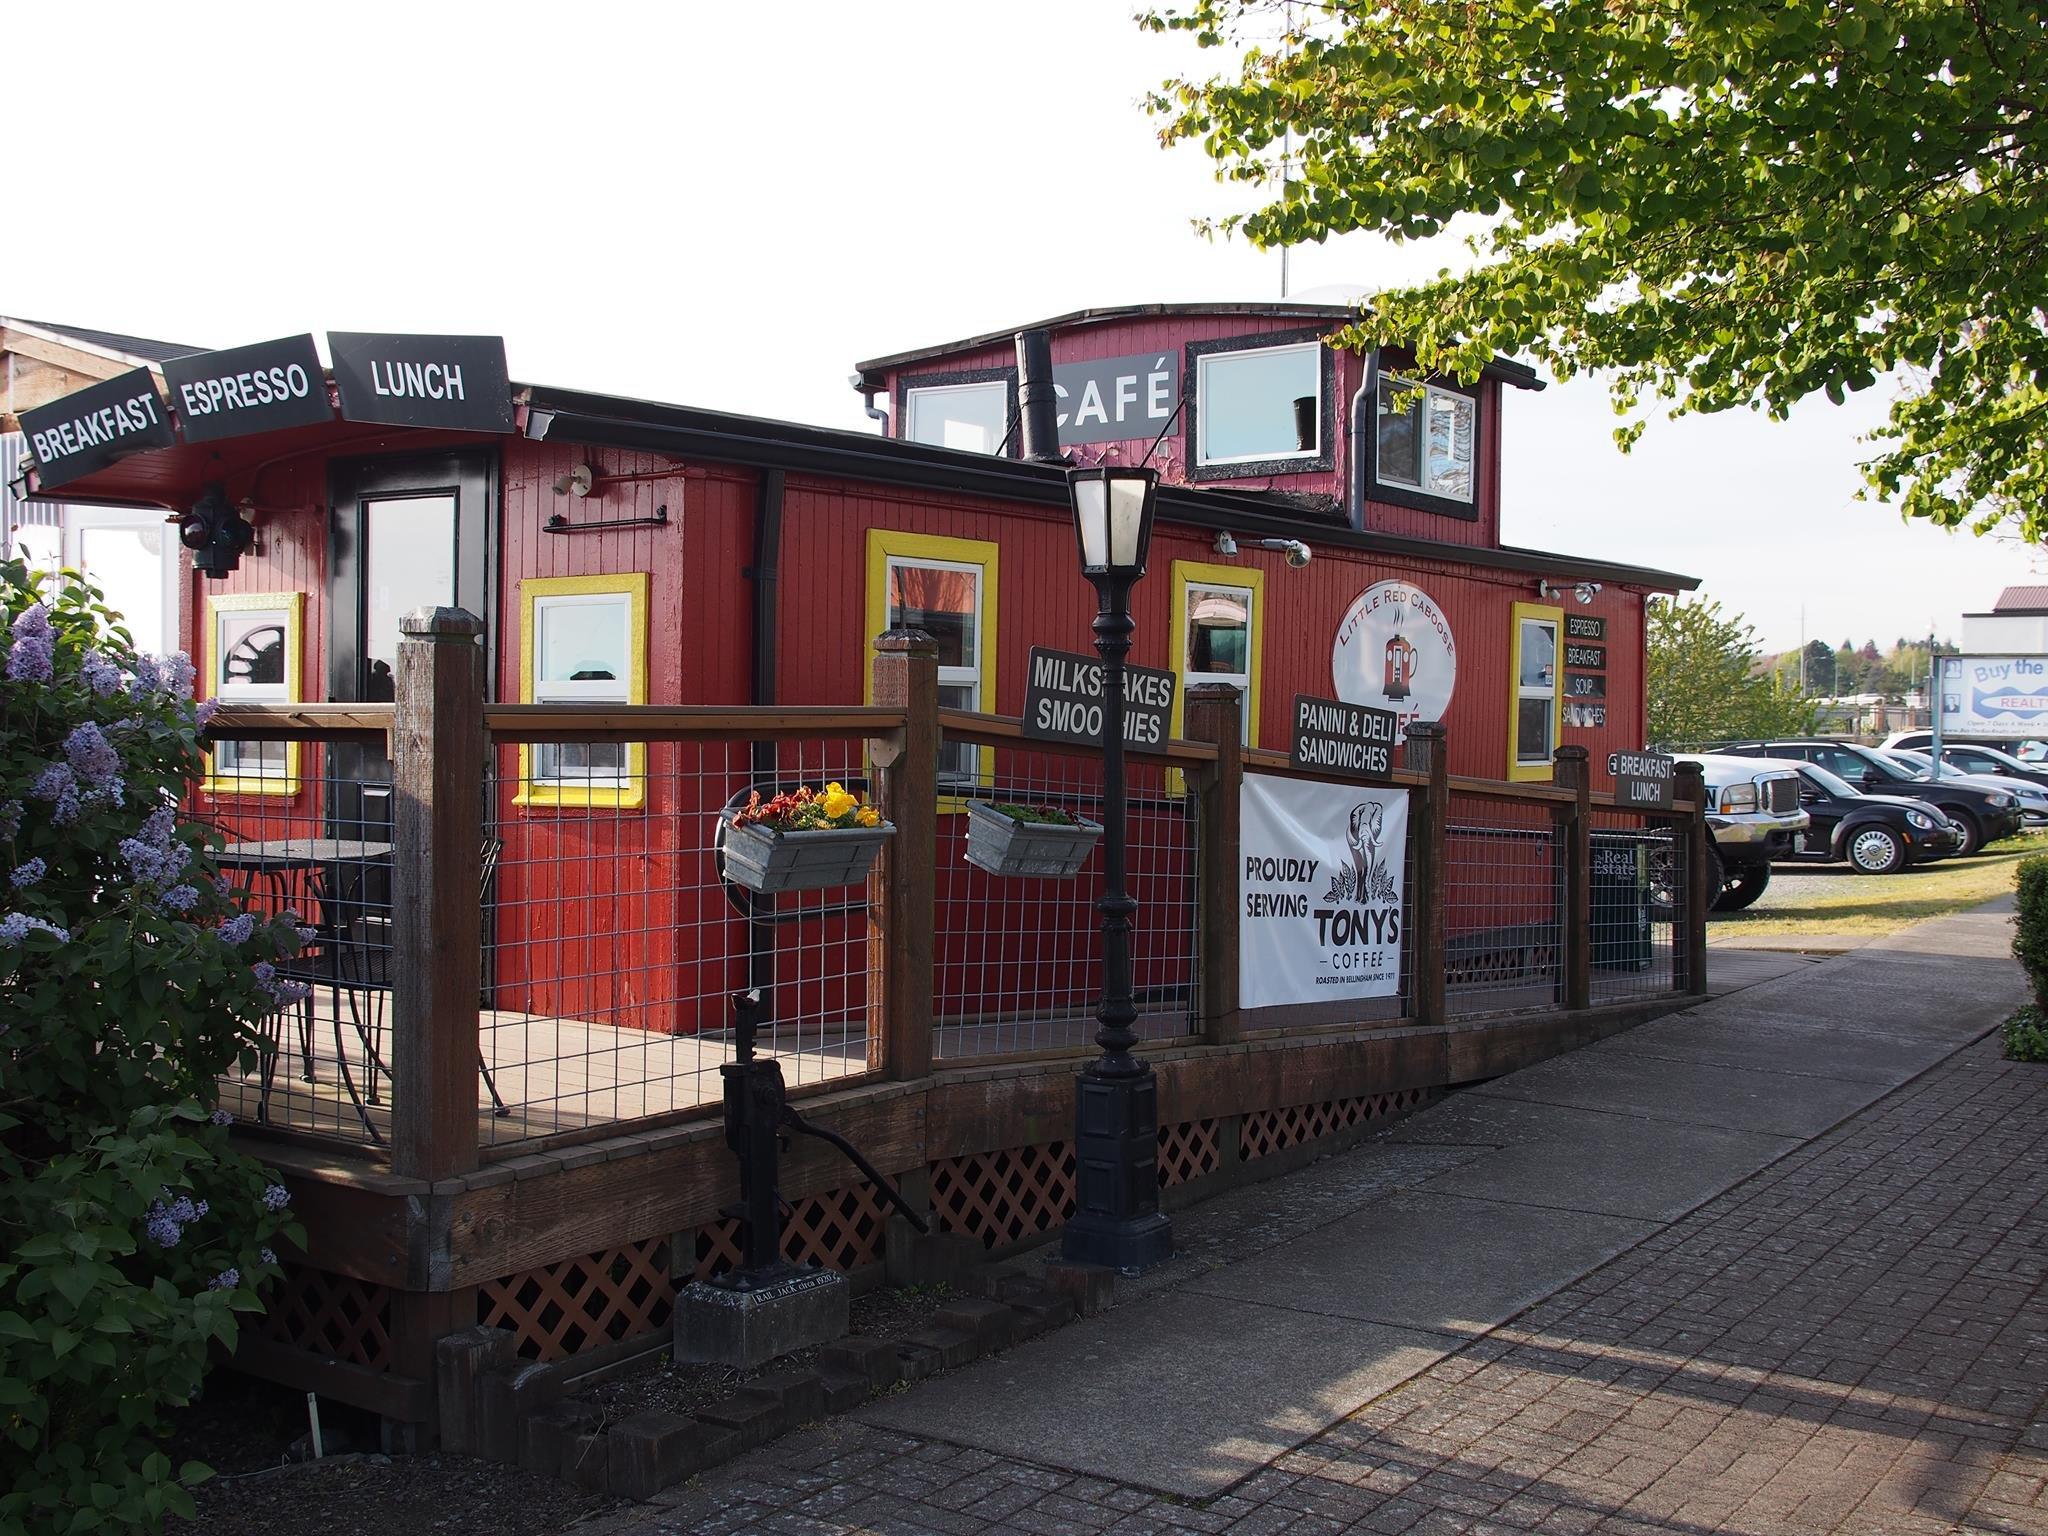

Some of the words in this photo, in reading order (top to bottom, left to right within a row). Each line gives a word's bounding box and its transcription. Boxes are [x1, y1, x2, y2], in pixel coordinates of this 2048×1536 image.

[180, 363, 309, 416] ESPRESSO
[371, 360, 465, 400] LUNCH
[32, 392, 158, 464] BREAKFAST
[1340, 596, 1380, 646] LITTLE
[1384, 589, 1407, 604] RED
[1410, 593, 1454, 657] CABOOSE
[1570, 618, 1600, 637] ESPRESSO
[1568, 647, 1601, 666] BREAKFAST
[1034, 656, 1171, 708] MILKSAKES
[1974, 664, 2011, 683] Buy
[2015, 659, 2044, 675] the
[1575, 678, 1592, 695] SOUP
[2000, 697, 2048, 708] REALT
[1299, 702, 1346, 735] PANINI
[1349, 711, 1359, 737] &
[1362, 713, 1393, 742] DELI
[1299, 735, 1387, 773] SANDWICHES
[1620, 755, 1672, 779] BREAKFAST
[1631, 781, 1660, 802] LUNCH
[1593, 860, 1636, 875] Estate
[1604, 849, 1634, 864] Real
[1246, 856, 1319, 883] PROUDLY
[1246, 893, 1308, 918] SERVING
[1313, 906, 1399, 946] TONY'S
[1332, 951, 1383, 969] COFFEE
[1315, 976, 1339, 984] ROASTED
[1346, 974, 1372, 983] BELLINGHAM
[1372, 973, 1384, 981] SINCE
[756, 1291, 775, 1303] RAIL
[778, 1285, 797, 1296] JACK
[798, 1280, 816, 1290] circa
[816, 1274, 832, 1285] 1920
